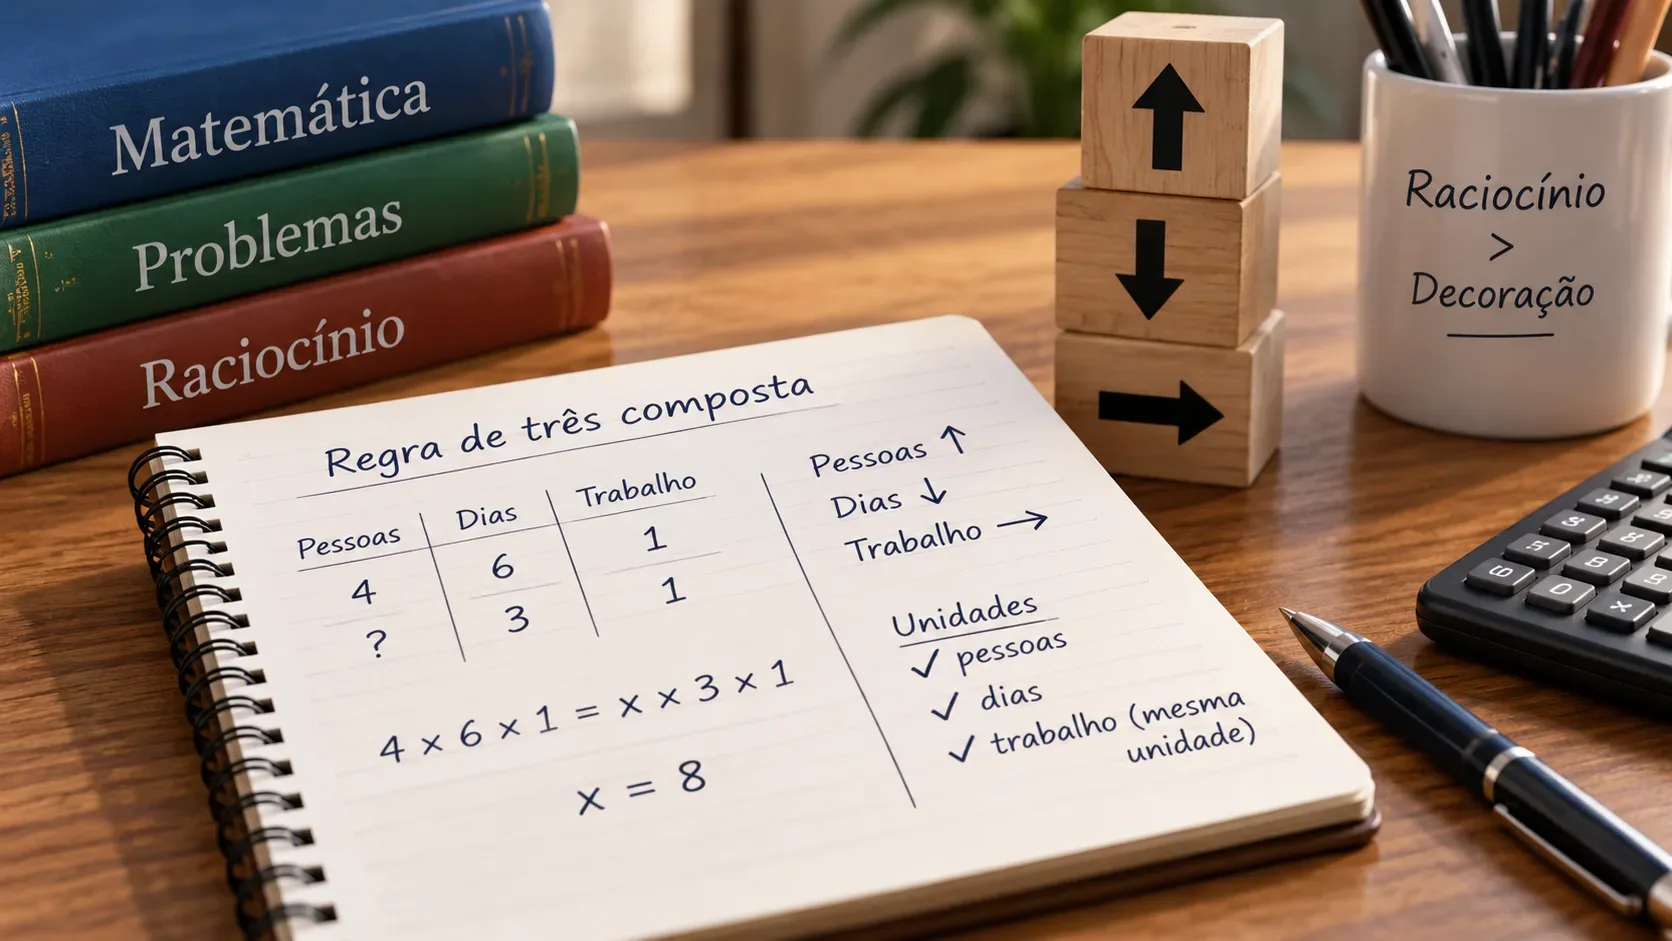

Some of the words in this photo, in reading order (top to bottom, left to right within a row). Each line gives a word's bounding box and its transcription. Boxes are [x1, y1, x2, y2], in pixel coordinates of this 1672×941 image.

[109, 75, 431, 176] Matemática
[1405, 168, 1606, 211] Raciocínio
[132, 200, 403, 293] Problemas
[1411, 271, 1595, 320] Decoração
[139, 308, 405, 409] Raciocínio
[324, 441, 444, 479] Regra
[460, 422, 507, 454] de
[520, 407, 602, 442] três
[621, 374, 815, 422] composta
[809, 442, 928, 479] Pessoas
[296, 528, 401, 560] Pessoas
[455, 506, 518, 531] Dias
[575, 472, 697, 509] Trabalho
[829, 492, 903, 519] Dias
[350, 578, 377, 605] 4
[491, 552, 515, 580] 6
[643, 525, 668, 552] 1
[843, 520, 982, 562] Trabalho
[365, 629, 387, 659] ?
[504, 605, 530, 634] 3
[661, 576, 687, 605] 1
[892, 594, 1038, 638] Unidades
[956, 632, 1068, 678] pessoas
[379, 734, 406, 764] 4
[459, 718, 483, 748] 6
[535, 704, 559, 734] 1
[618, 694, 644, 719] x
[694, 673, 720, 703] 3
[770, 658, 795, 688] 1
[980, 684, 1043, 711] dias
[989, 711, 1118, 755] trabalho
[1128, 691, 1246, 731] (mesma
[1126, 717, 1257, 764] unidade)
[576, 786, 606, 817] x
[678, 759, 707, 793] 8
